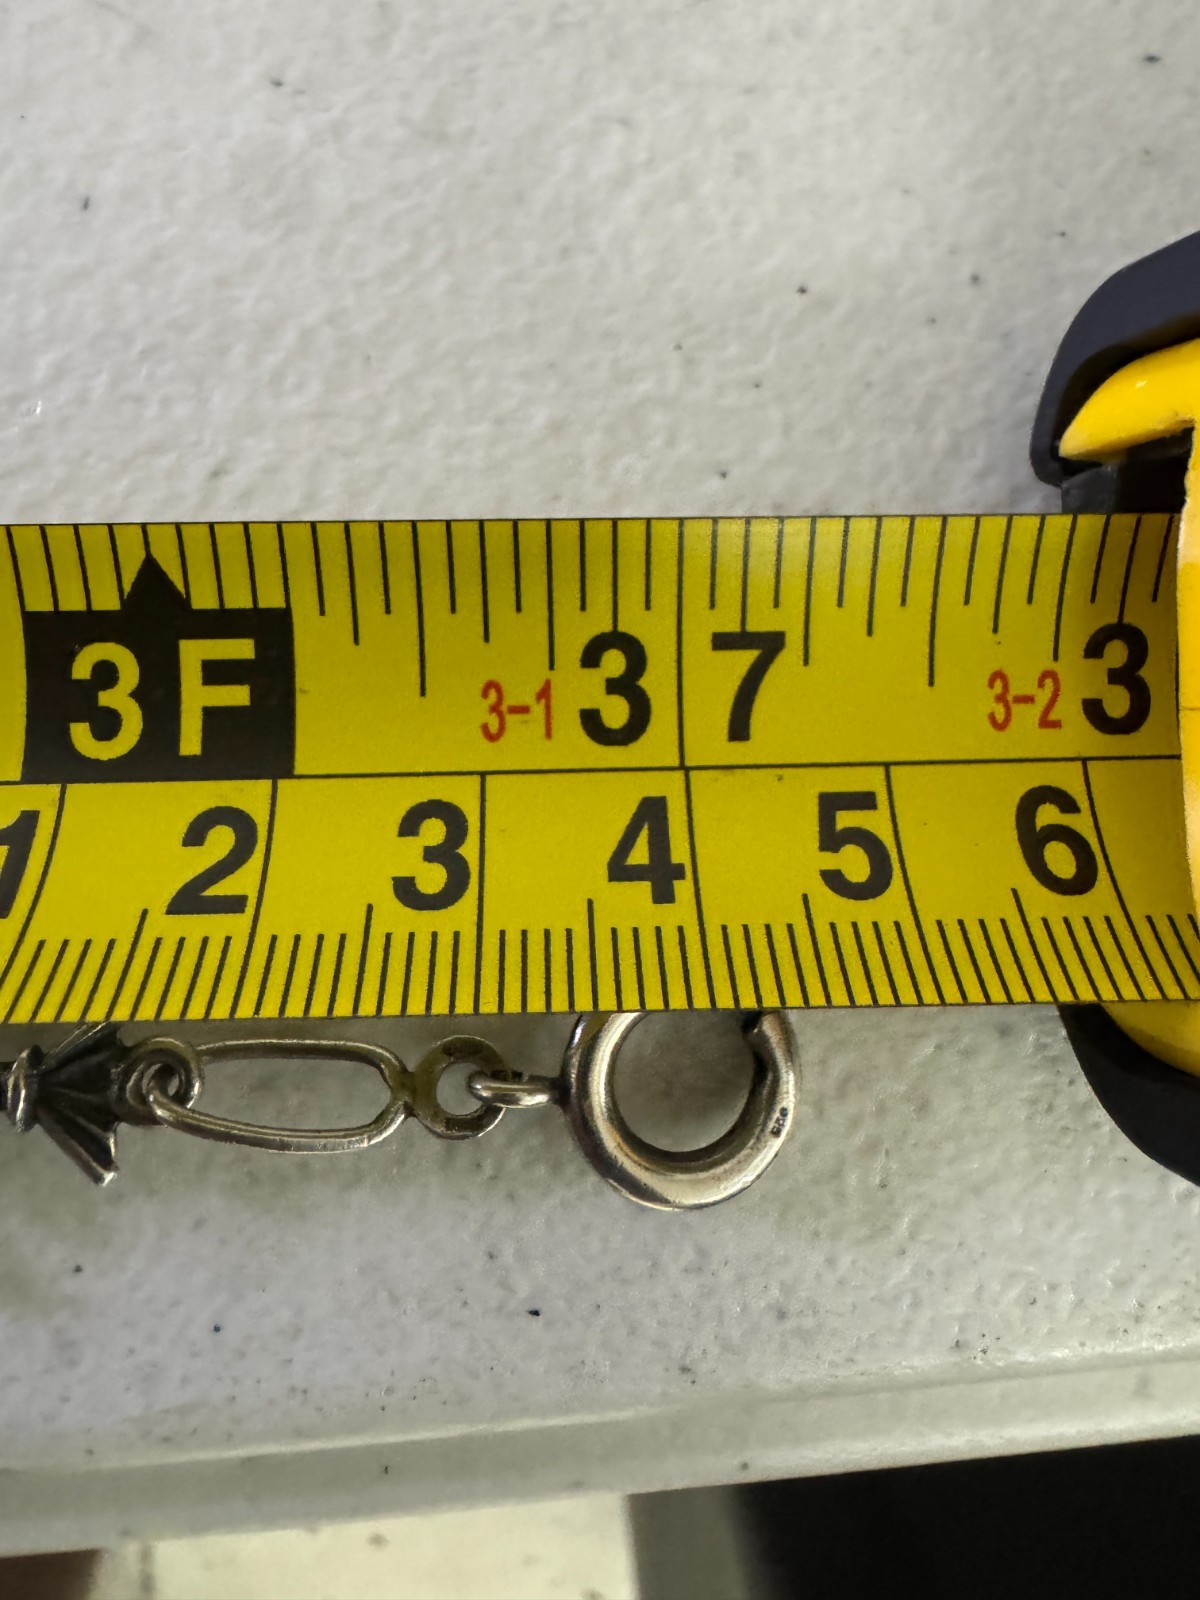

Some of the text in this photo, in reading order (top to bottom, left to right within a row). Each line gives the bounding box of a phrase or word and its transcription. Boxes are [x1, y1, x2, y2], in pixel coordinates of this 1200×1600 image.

[481, 679, 553, 743] 3-1
[987, 669, 1062, 732] 3-2
[0, 809, 41, 919] 1
[165, 805, 259, 915] 2
[391, 799, 472, 911] 3
[606, 795, 686, 905] 4
[817, 791, 894, 901] 5
[1014, 785, 1099, 896] 6
